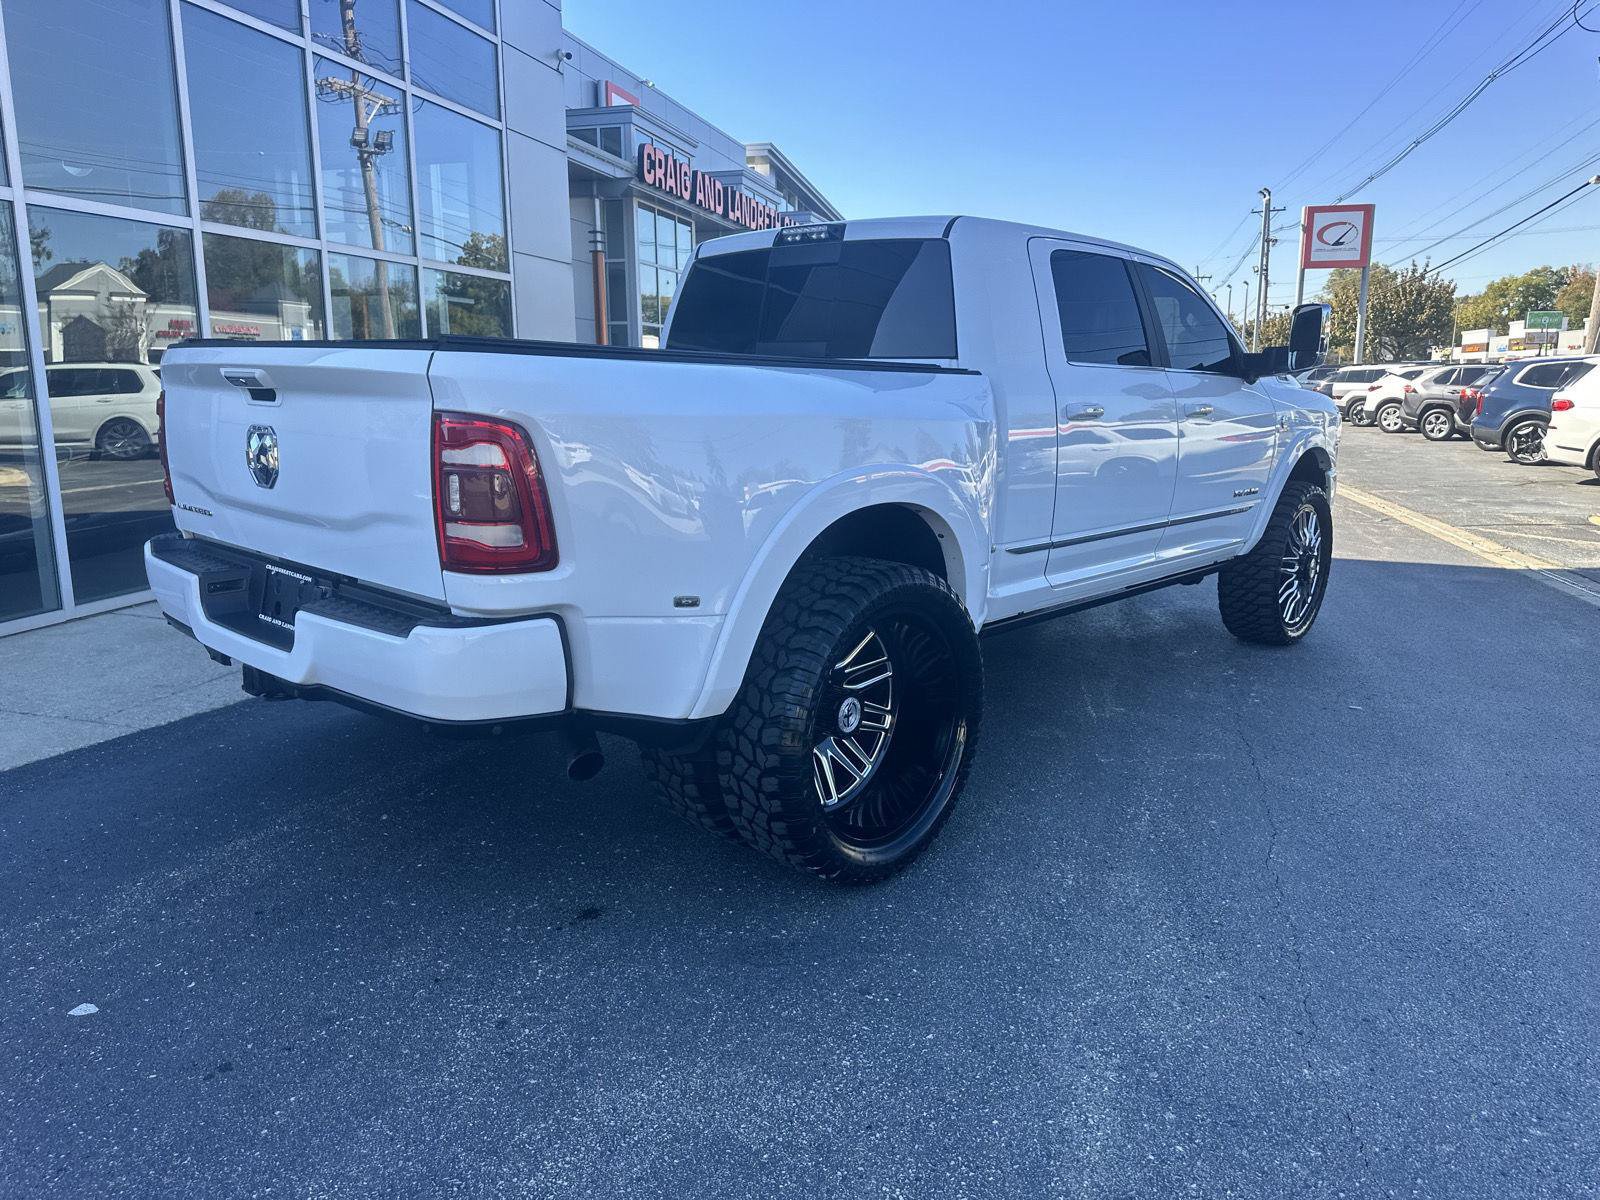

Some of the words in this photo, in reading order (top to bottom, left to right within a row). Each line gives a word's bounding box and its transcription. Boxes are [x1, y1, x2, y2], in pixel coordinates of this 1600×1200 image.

[639, 142, 692, 200] CRAIG
[694, 169, 723, 215] AND
[725, 185, 782, 230] LANDRETH
